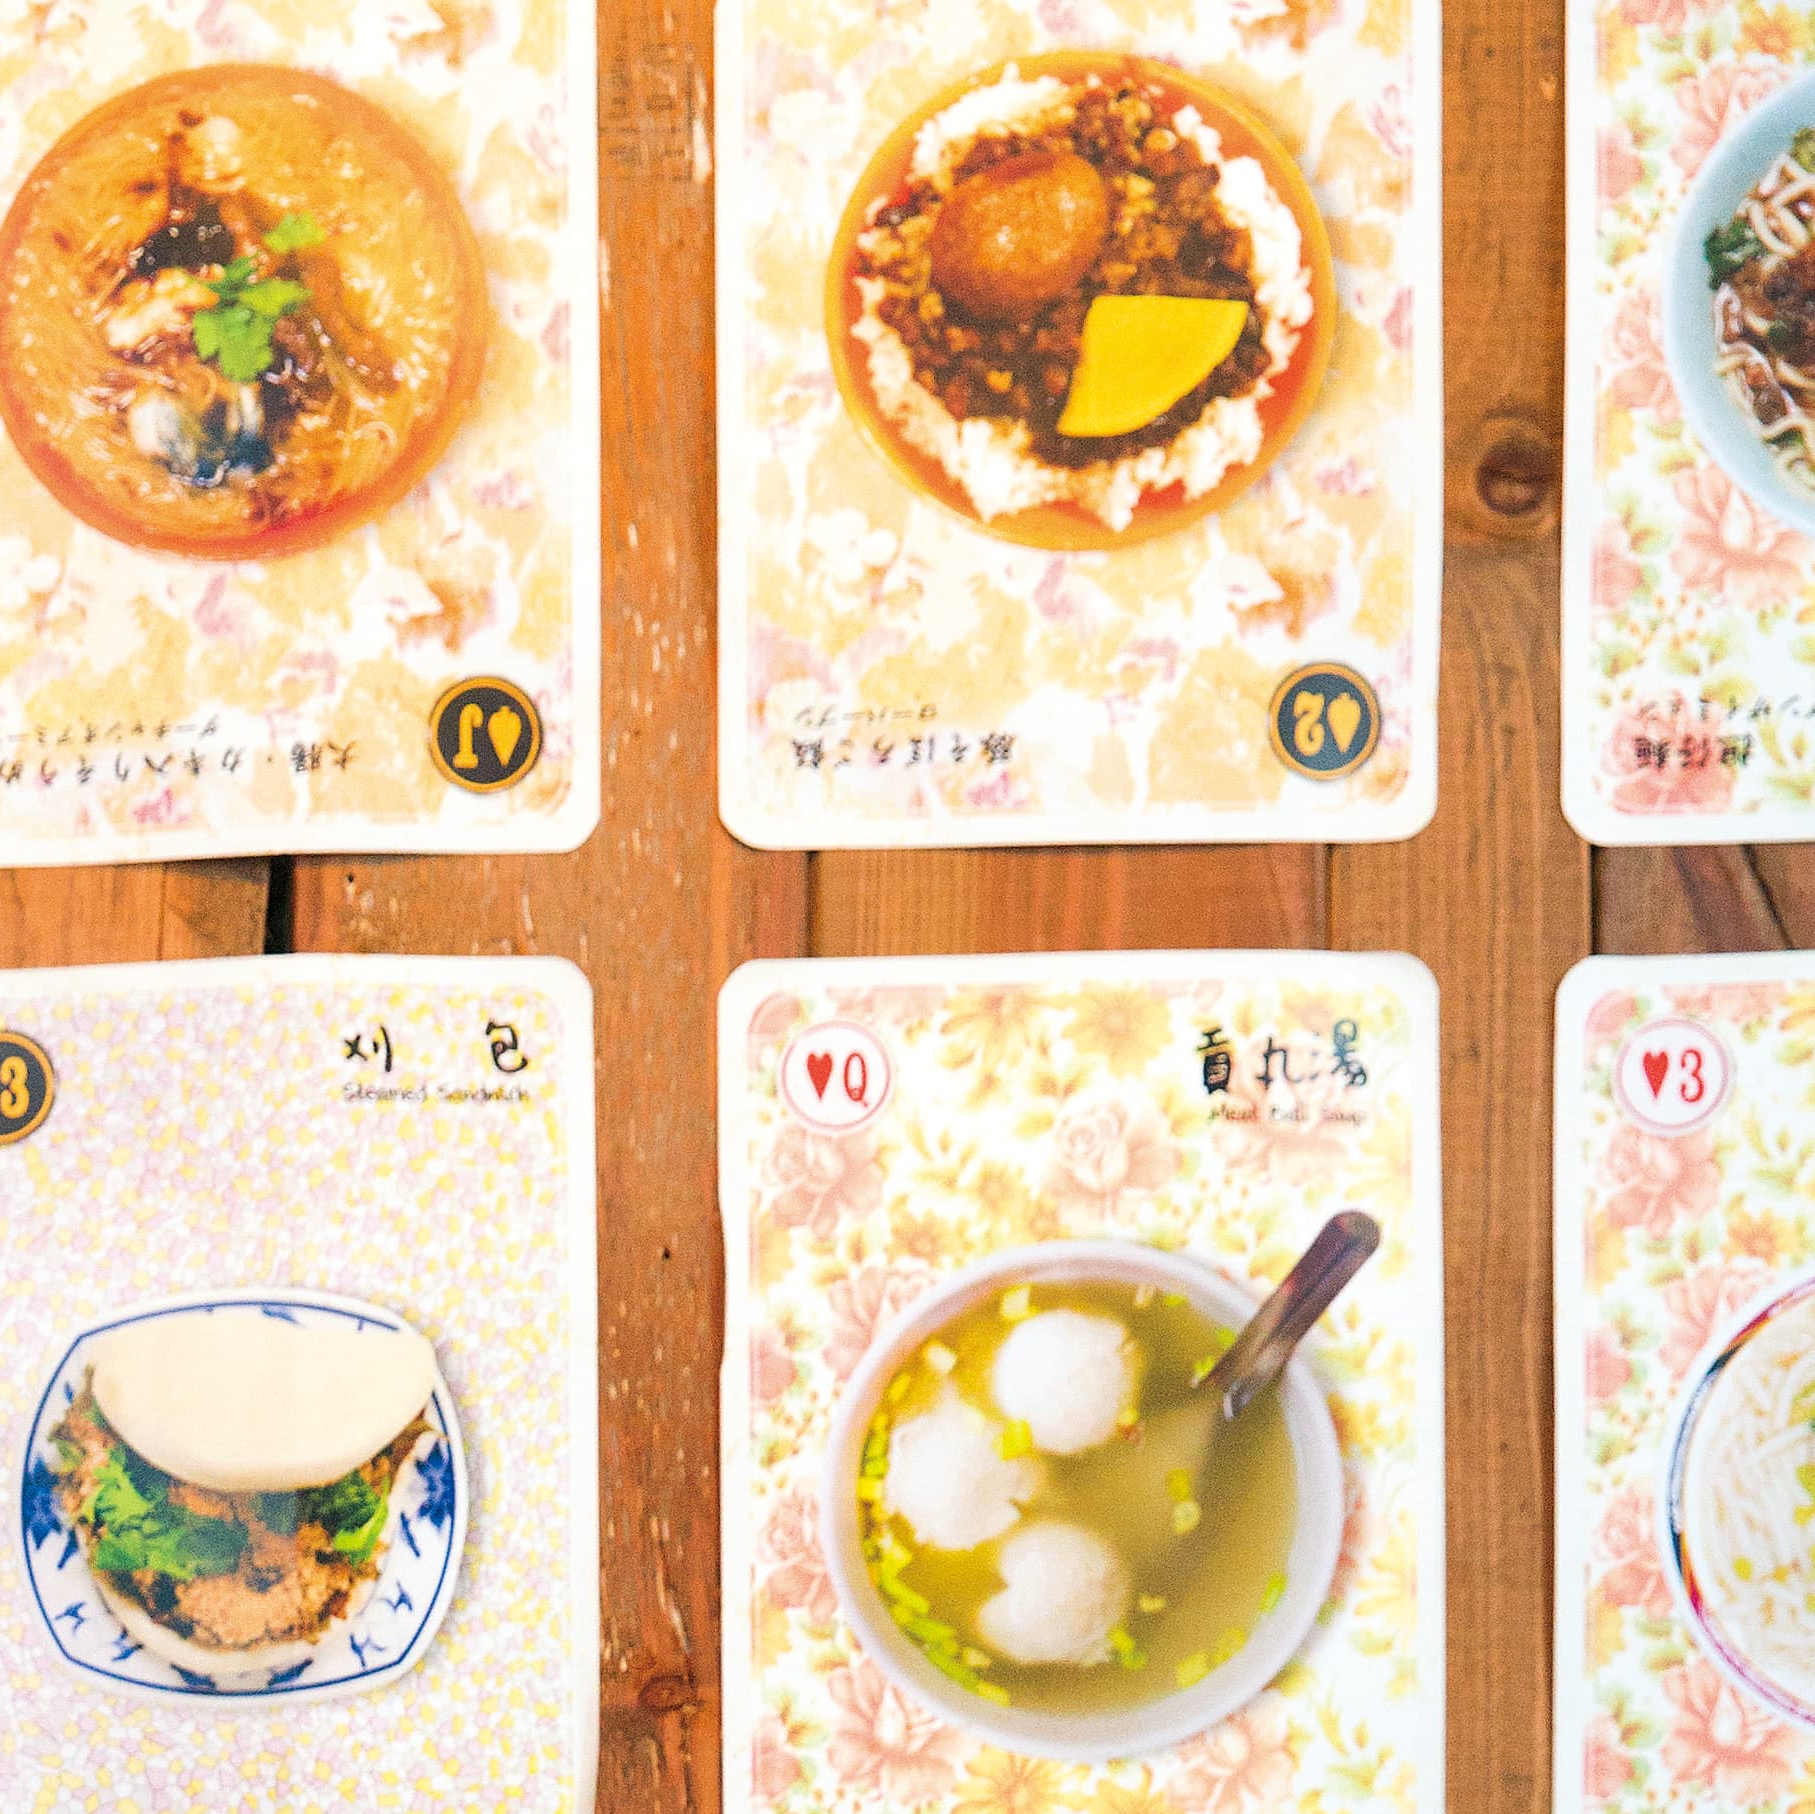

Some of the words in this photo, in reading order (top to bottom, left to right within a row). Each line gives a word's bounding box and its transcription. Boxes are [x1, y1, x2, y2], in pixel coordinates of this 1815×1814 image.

[454, 704, 484, 768] J
[1293, 691, 1325, 758] 2
[843, 1051, 869, 1108] Q
[1680, 1048, 1705, 1104] 3
